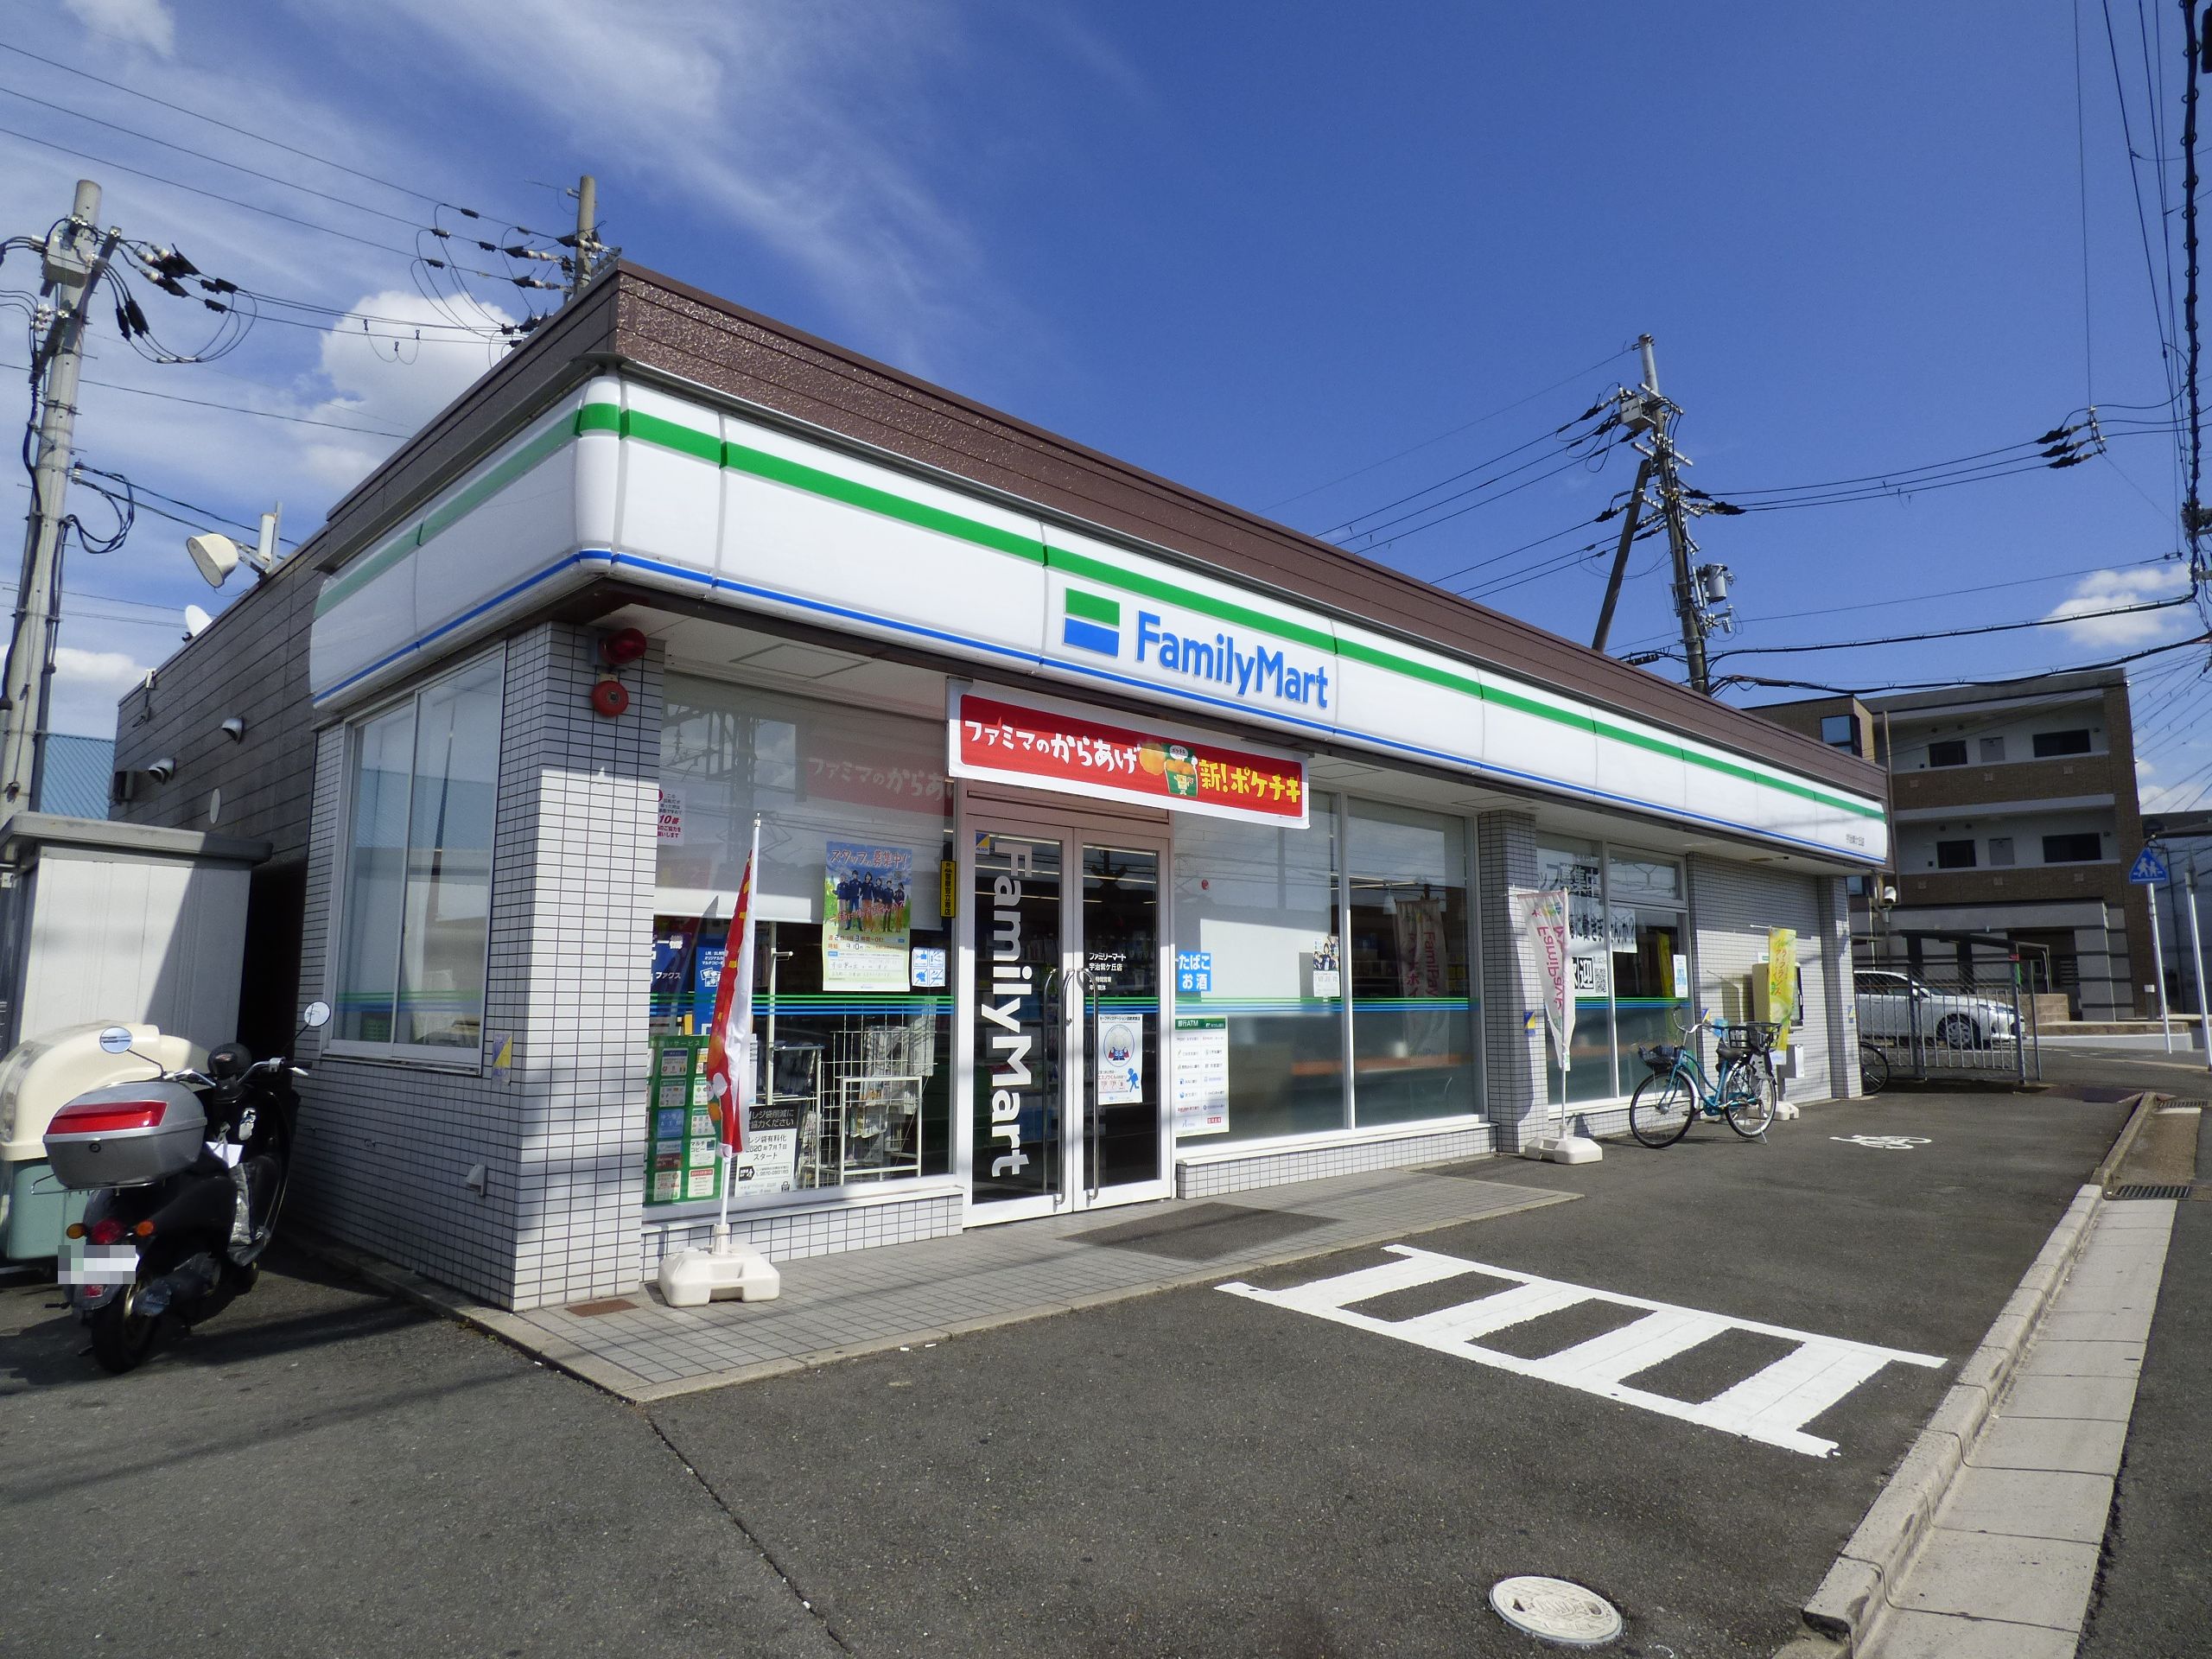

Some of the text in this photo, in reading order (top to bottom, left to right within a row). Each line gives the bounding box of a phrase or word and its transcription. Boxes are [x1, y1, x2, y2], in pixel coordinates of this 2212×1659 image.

[1136, 610, 1328, 709] FamilyMart
[964, 720, 1141, 774] ファミマのからあげ
[1198, 759, 1301, 804] 新!ポケチキ
[1089, 952, 1127, 962] ファミリーマート
[1179, 954, 1211, 970] たばこ
[1182, 973, 1207, 990] お酒
[981, 842, 1033, 1177] FamilyMart
[748, 1118, 794, 1129] 協力ください
